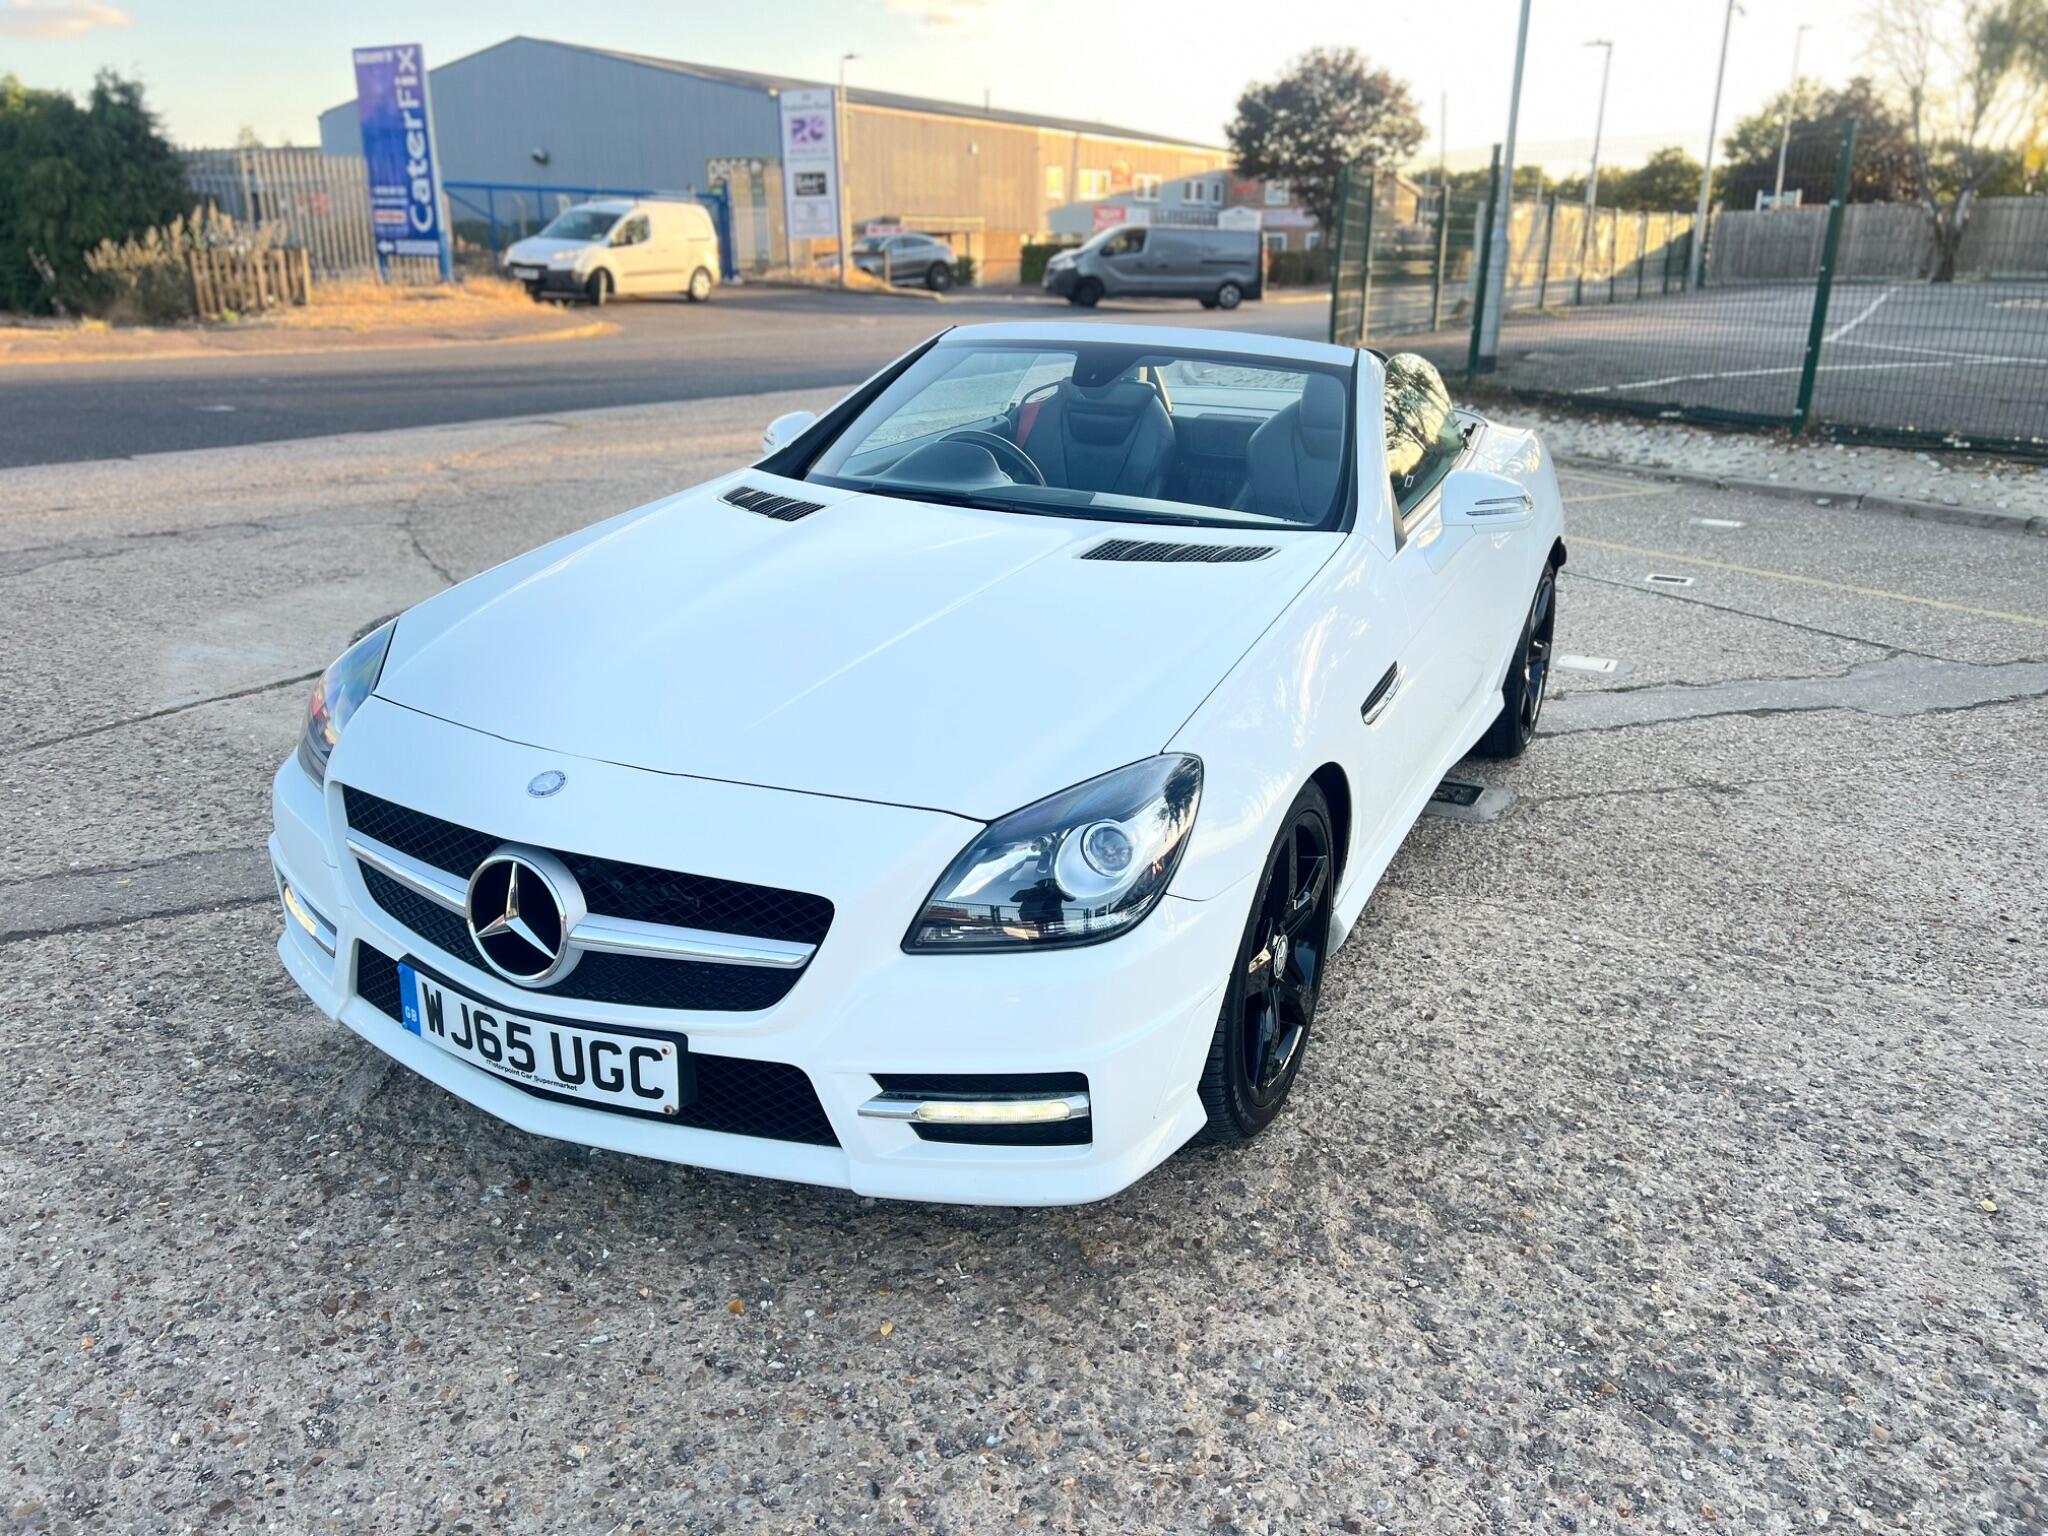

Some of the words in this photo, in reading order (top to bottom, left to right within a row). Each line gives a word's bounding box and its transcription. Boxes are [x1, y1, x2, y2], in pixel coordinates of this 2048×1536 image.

[404, 1004, 418, 1023] GB
[421, 982, 536, 1073] WJ65
[550, 1031, 664, 1100] UGC
[521, 1071, 532, 1079] Car
